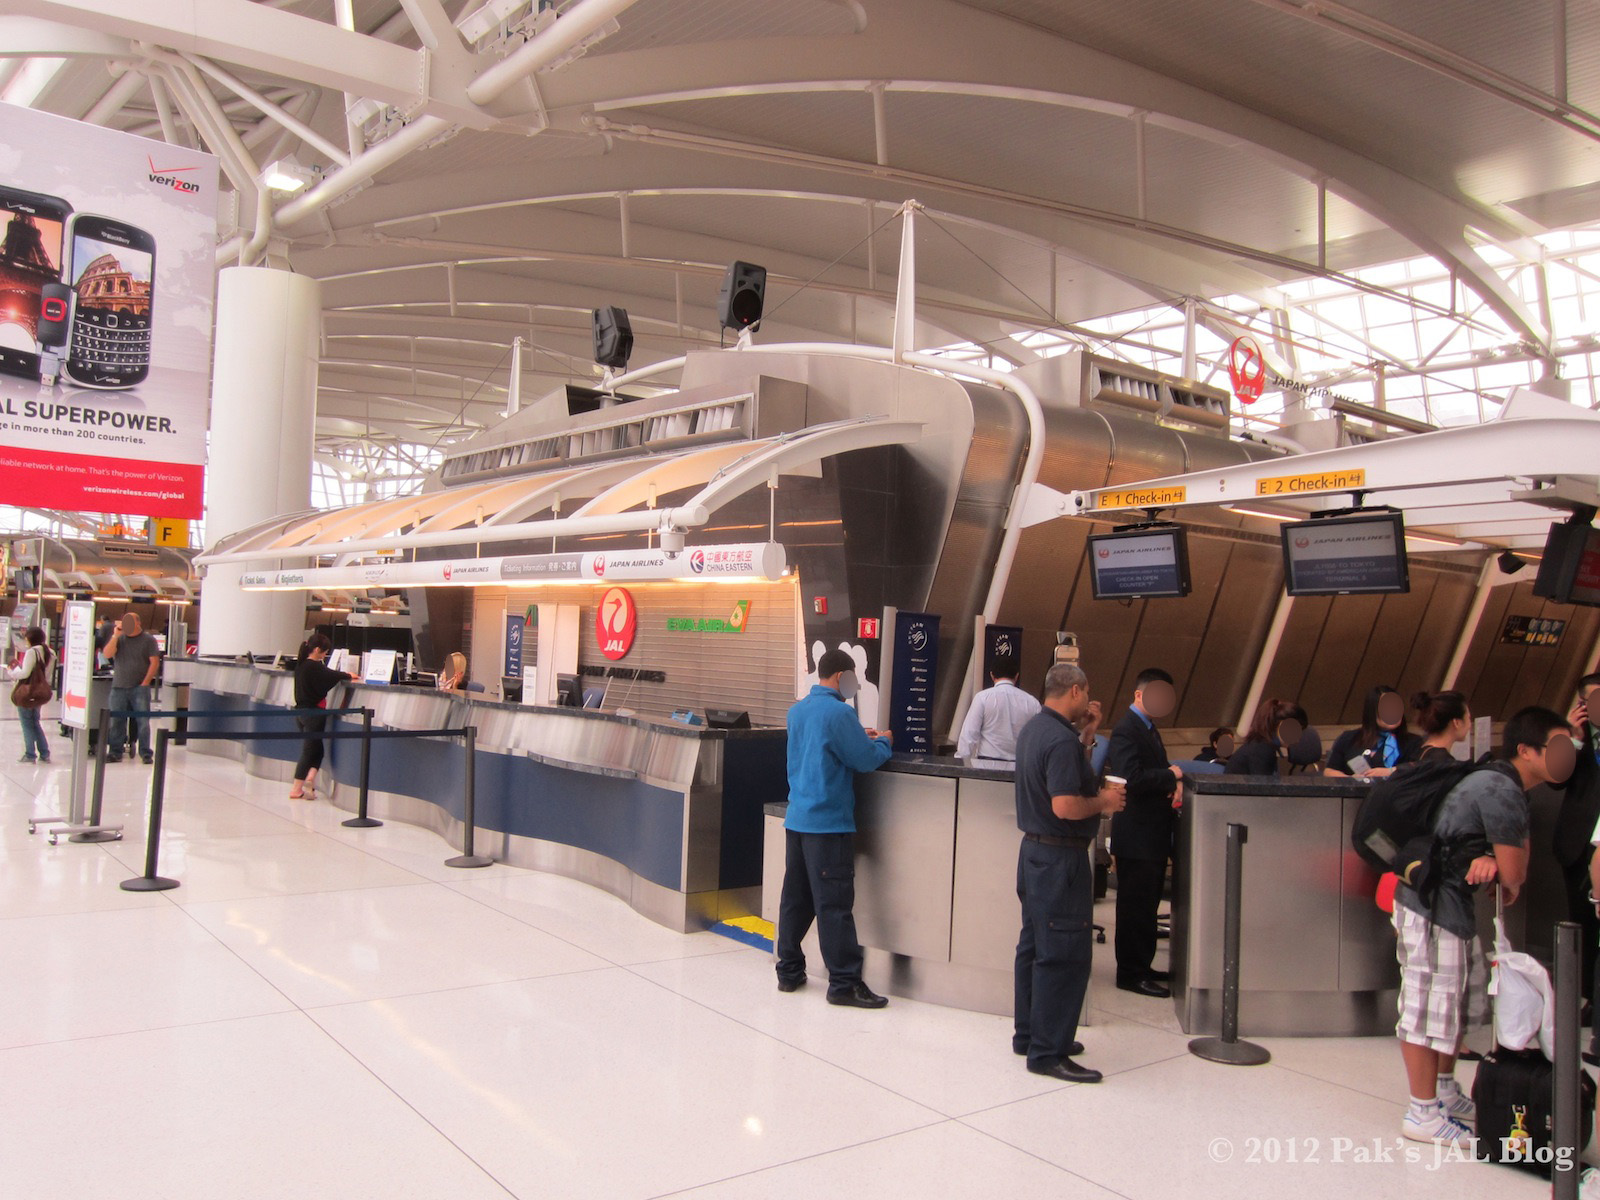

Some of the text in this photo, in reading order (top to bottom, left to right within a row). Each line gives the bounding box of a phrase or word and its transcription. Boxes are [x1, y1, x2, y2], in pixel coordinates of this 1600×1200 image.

[149, 174, 200, 194] verizon
[1272, 375, 1308, 393] JAPAN
[24, 400, 177, 434] SUPERPOWER.
[11, 421, 21, 431] in
[23, 425, 49, 434] more
[52, 427, 74, 437] than
[76, 429, 95, 439] 200
[97, 433, 146, 444] countries.
[23, 460, 55, 471] network
[111, 469, 124, 477] the
[124, 470, 147, 479] power
[148, 472, 157, 480] of
[1260, 474, 1346, 494] E 2 Check-in
[83, 486, 185, 500] verizonwireless.com/global
[1101, 490, 1171, 506] E 1 Check-in
[162, 527, 172, 542] F
[609, 559, 664, 568] JAPAN AIRLINES
[706, 562, 753, 573] CHINA EASTERN
[667, 617, 695, 631] EVA
[603, 639, 625, 653] JAL
